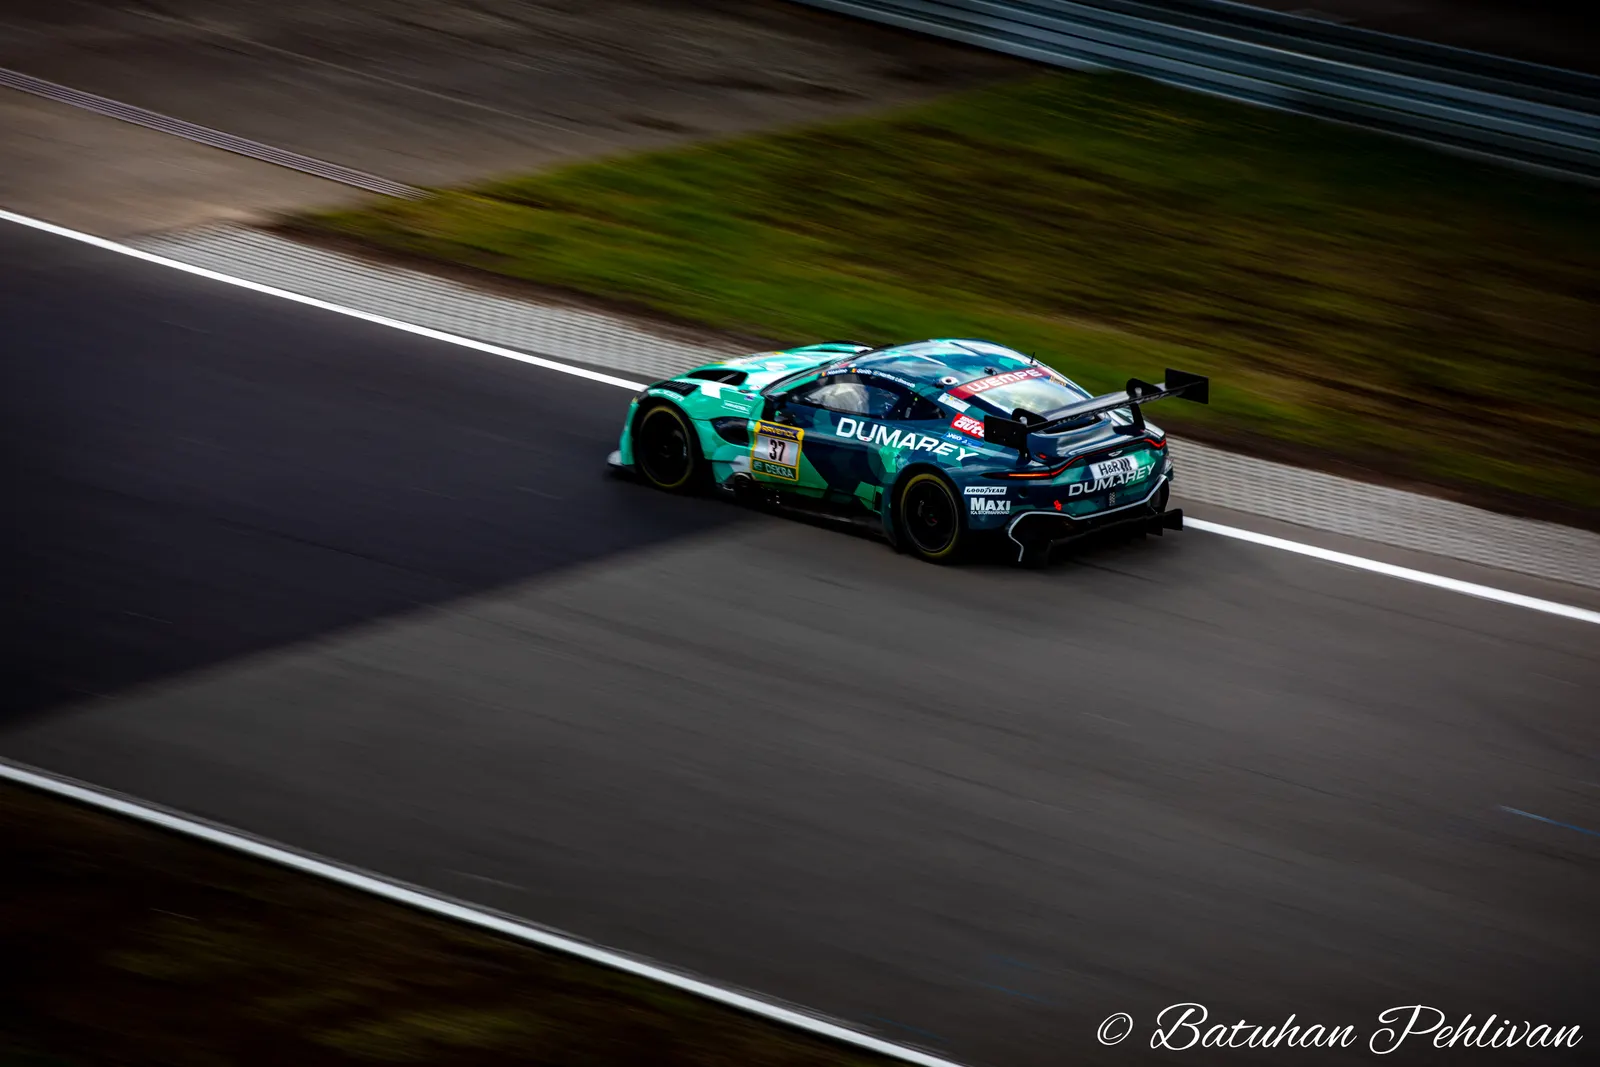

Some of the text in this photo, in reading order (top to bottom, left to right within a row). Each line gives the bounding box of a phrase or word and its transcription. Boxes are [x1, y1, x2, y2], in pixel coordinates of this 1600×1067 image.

[966, 369, 1043, 392] WEMPE
[761, 425, 796, 438] RAVENOL
[836, 417, 979, 461] DUMAREY
[769, 439, 785, 462] 37
[765, 463, 794, 478] DEKRA
[1068, 461, 1156, 497] DUMAREY
[1098, 461, 1120, 477] H&R
